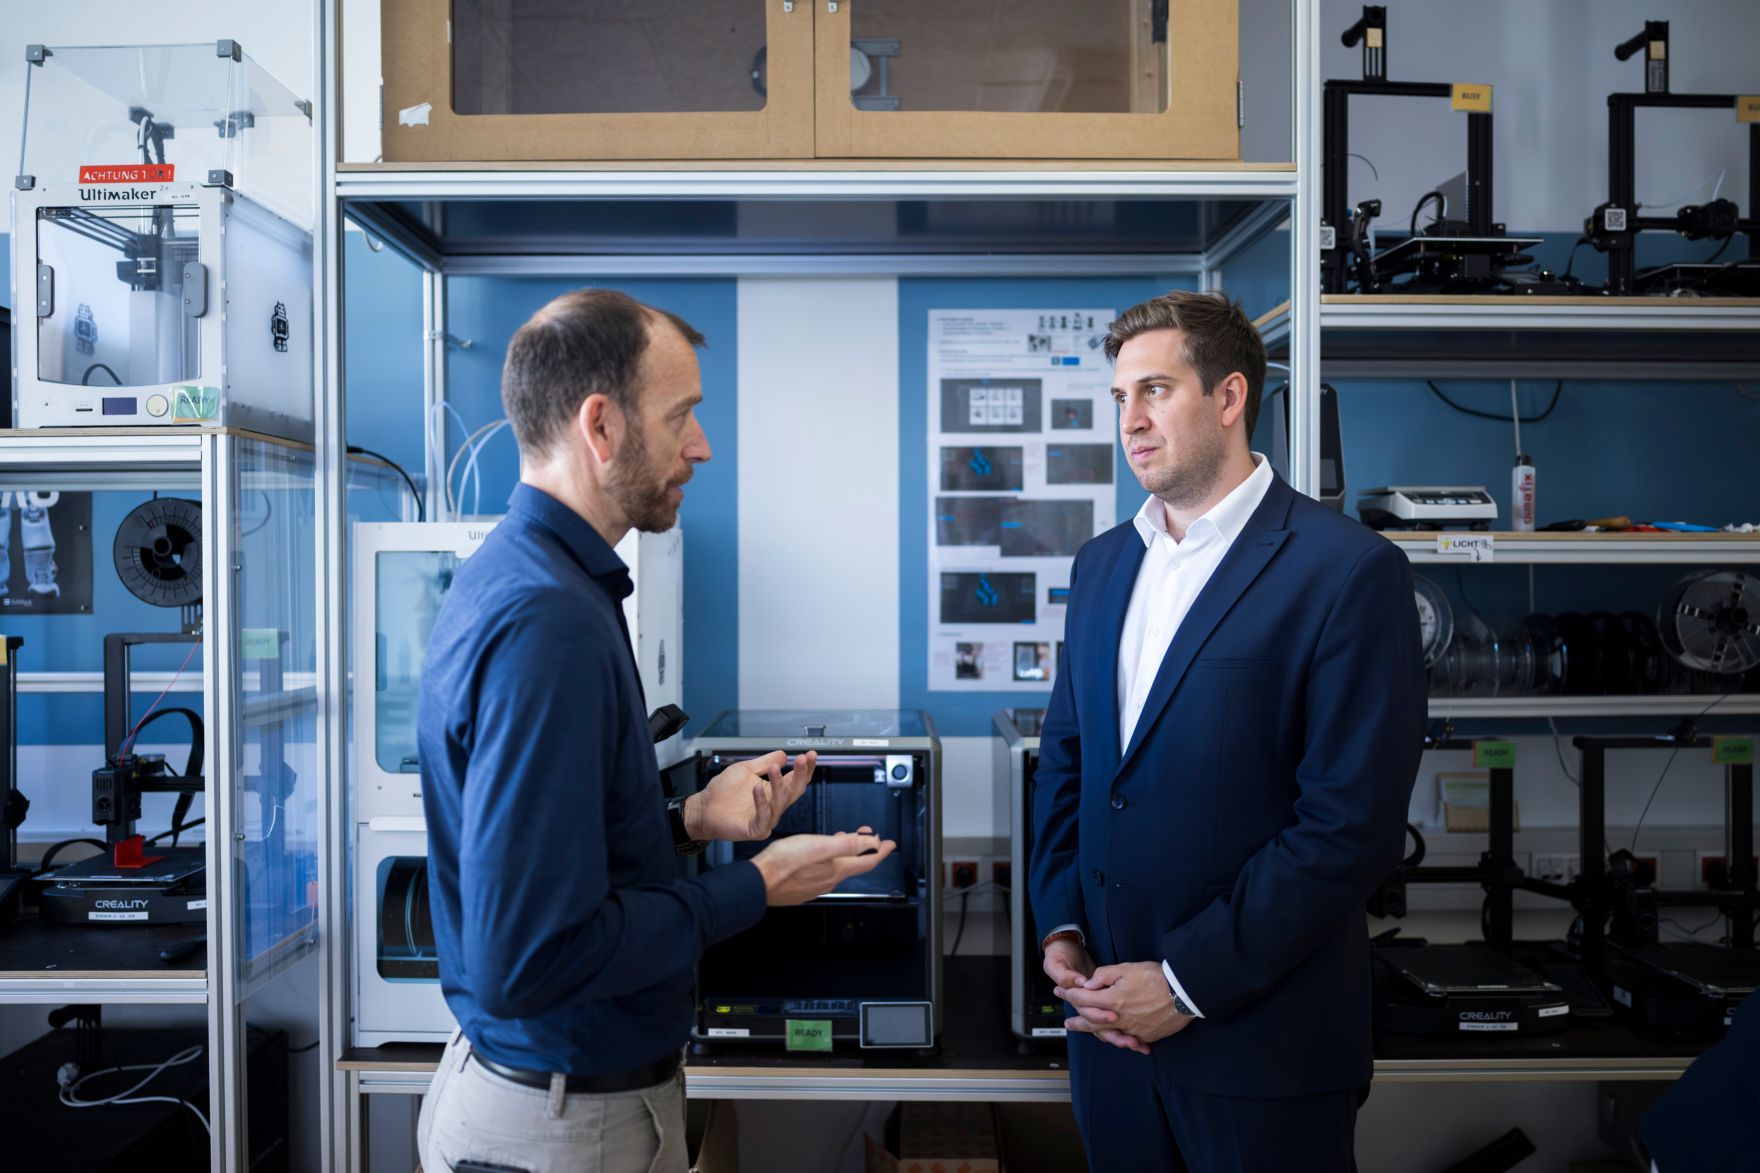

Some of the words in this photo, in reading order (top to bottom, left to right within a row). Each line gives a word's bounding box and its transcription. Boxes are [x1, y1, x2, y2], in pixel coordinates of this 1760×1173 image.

[1461, 92, 1481, 100] BUSY
[83, 170, 138, 180] ACHTUNG
[78, 188, 157, 201] Ultimaker
[1453, 540, 1479, 548] LICHT
[95, 900, 149, 909] CREALITY
[1459, 1011, 1512, 1020] CREALITY
[795, 1028, 824, 1037] READY
